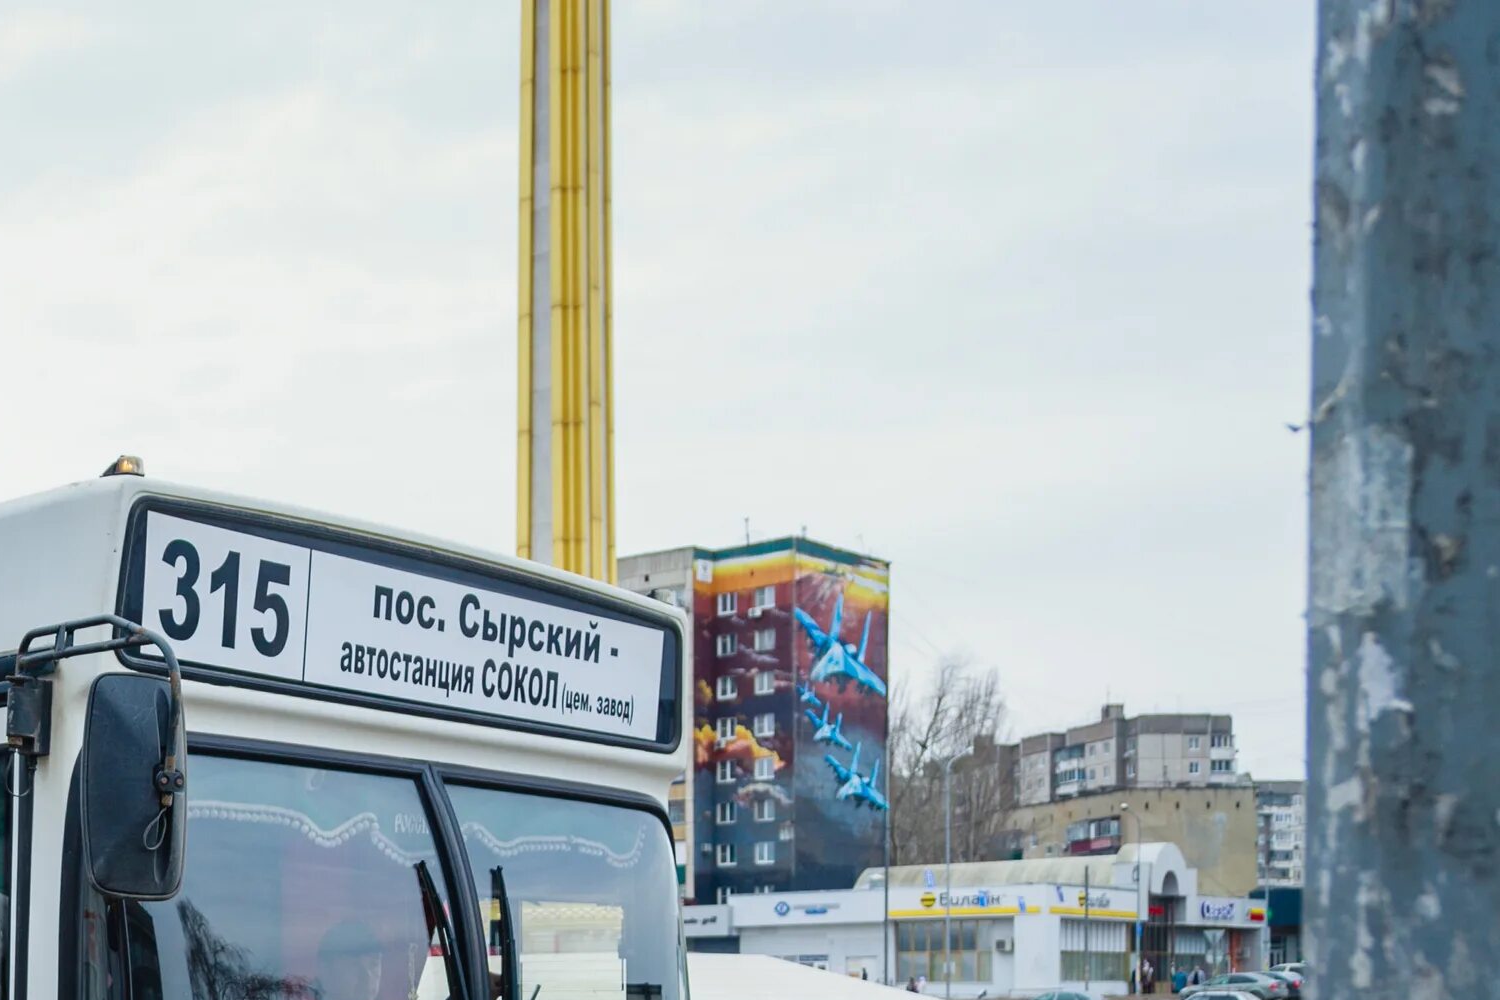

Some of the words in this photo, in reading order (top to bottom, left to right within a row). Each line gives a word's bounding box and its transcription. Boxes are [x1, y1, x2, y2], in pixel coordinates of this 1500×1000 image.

[158, 538, 291, 658] 315
[373, 584, 446, 633] пос.
[459, 592, 602, 664] Сырский
[340, 640, 475, 697] автостанция
[481, 659, 558, 710] СОКОЛ
[560, 682, 593, 716] (цем.
[597, 694, 635, 727] завод)
